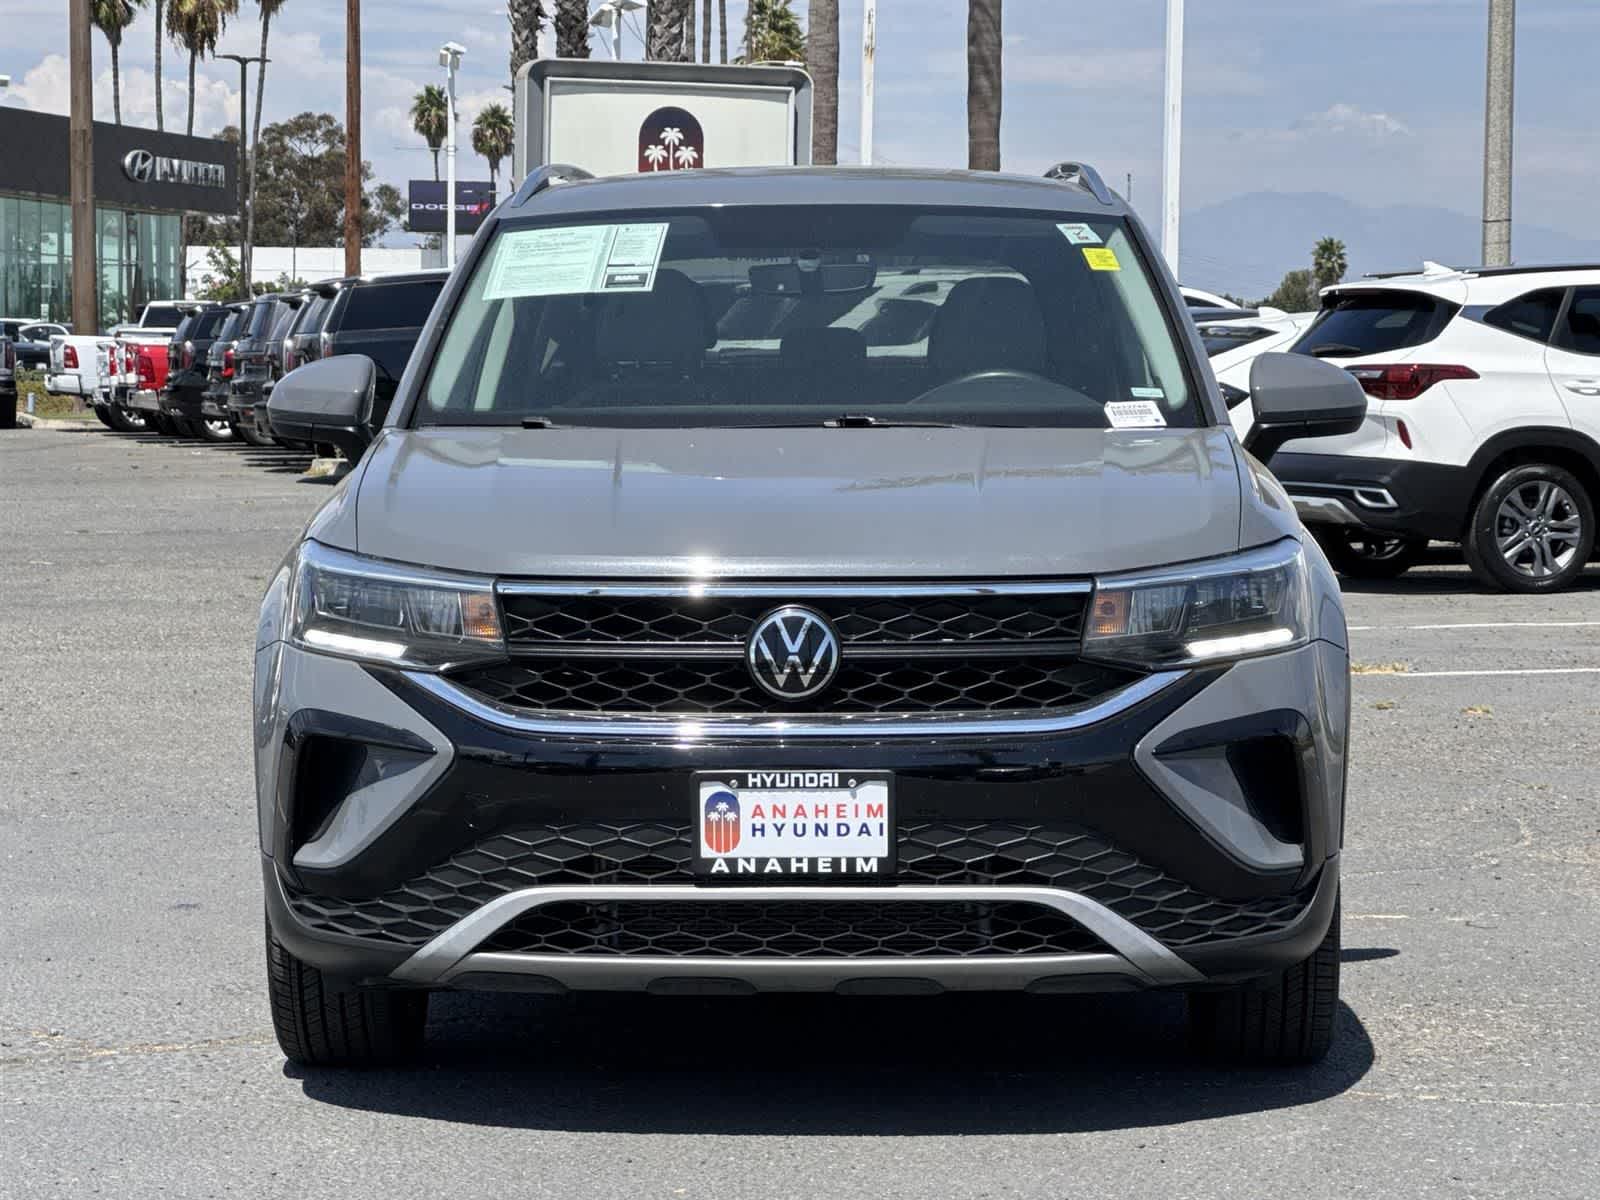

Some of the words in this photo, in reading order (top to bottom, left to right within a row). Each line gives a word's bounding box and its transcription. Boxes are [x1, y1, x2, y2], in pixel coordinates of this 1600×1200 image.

[411, 203, 478, 211] DODGE
[748, 773, 839, 788] HYUNDAI
[751, 803, 885, 819] ANAHEIM
[751, 822, 884, 837] HYUNDAI
[710, 857, 879, 873] ANAHEIM
